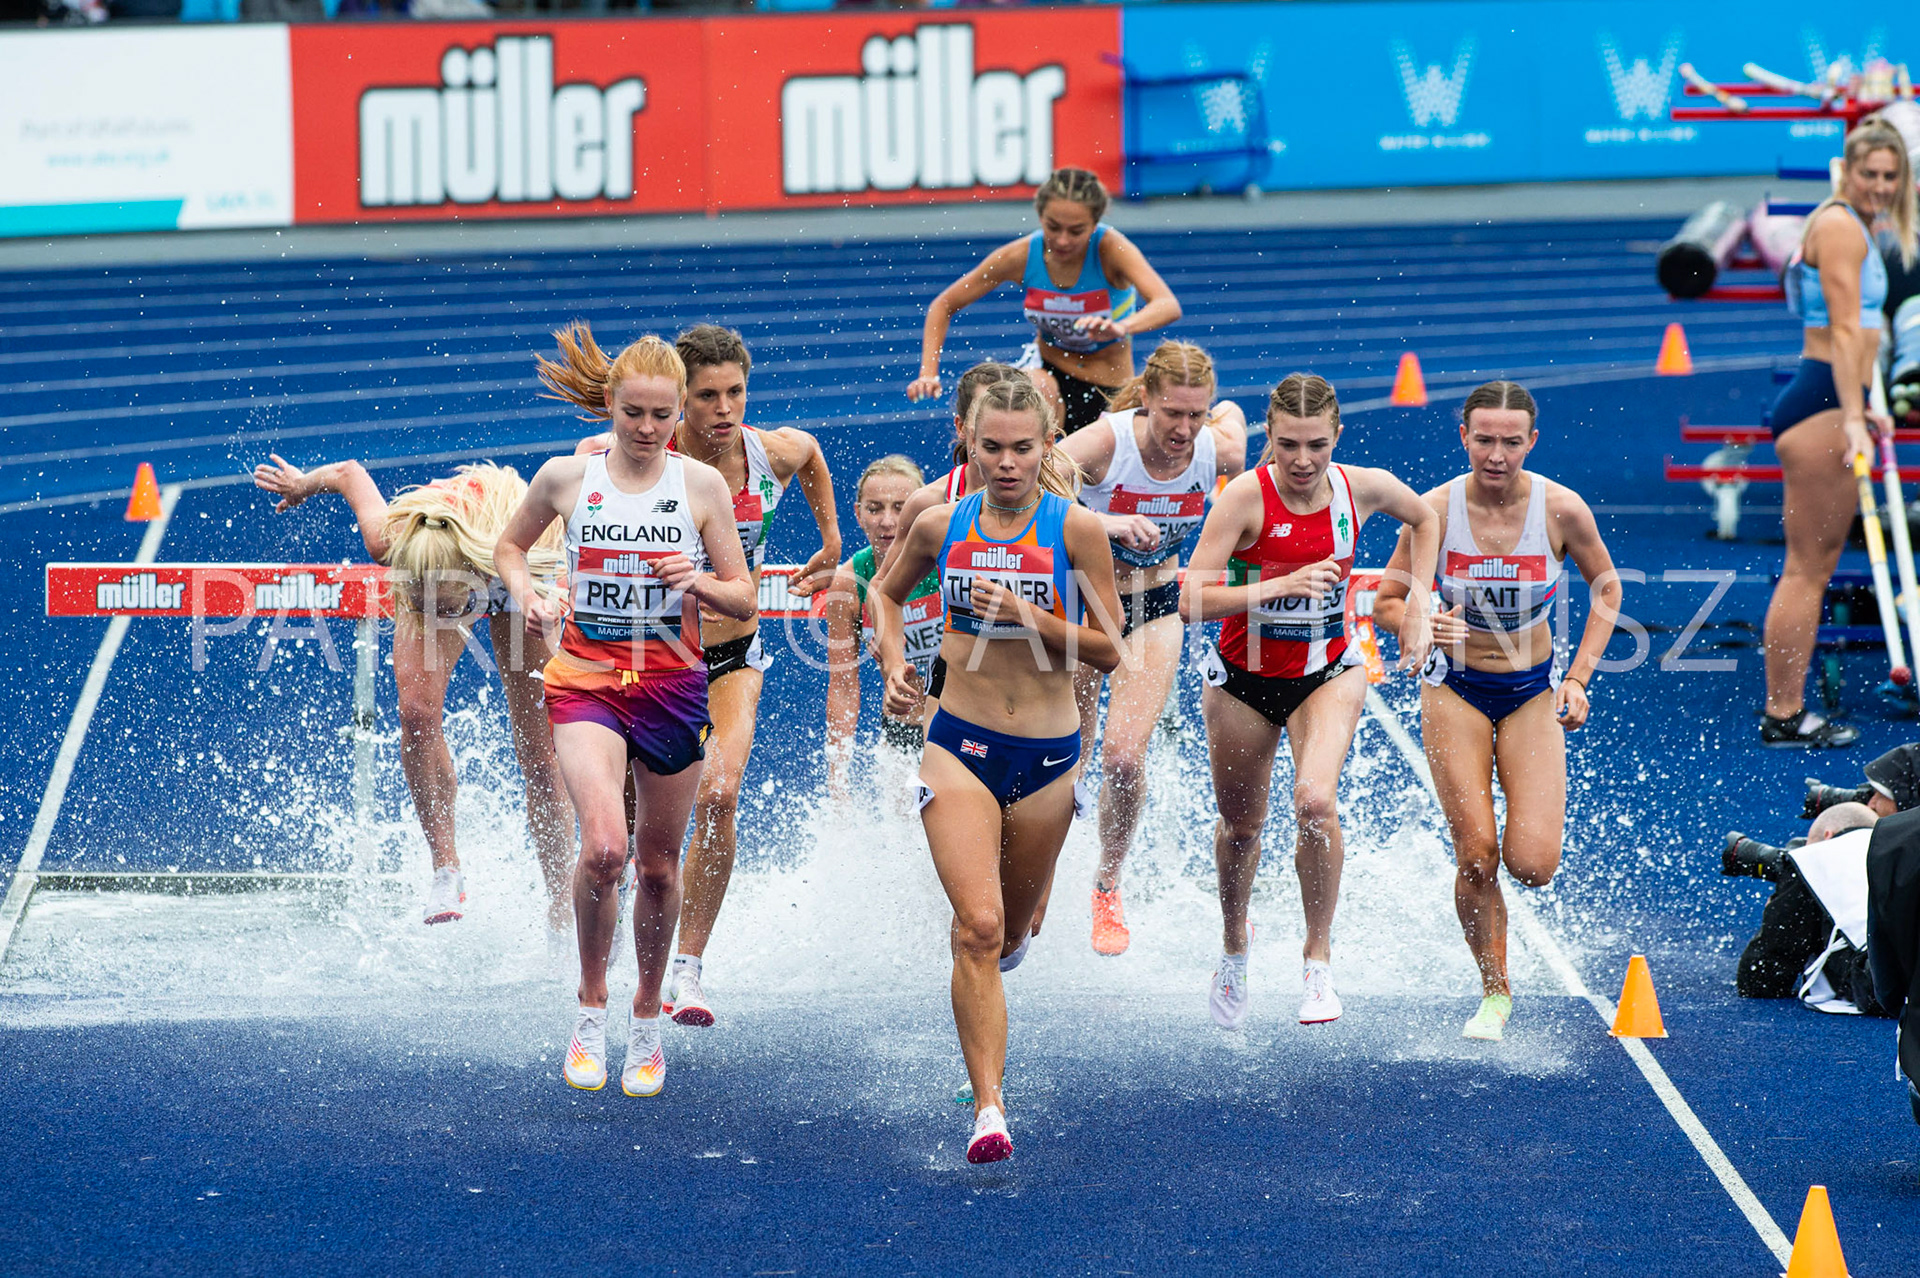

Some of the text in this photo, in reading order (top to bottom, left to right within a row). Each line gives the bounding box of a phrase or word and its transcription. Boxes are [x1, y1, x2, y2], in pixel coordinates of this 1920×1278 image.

[359, 34, 647, 207] müller
[781, 22, 1066, 195] müller
[1136, 496, 1183, 515] müller
[582, 524, 682, 543] ENGLAND
[971, 546, 1024, 570] müller
[1468, 558, 1520, 579] müller
[97, 573, 186, 610] müller
[255, 573, 345, 610] müller
[587, 580, 671, 611] PRATT
[947, 575, 1050, 605] THNER
[1465, 586, 1520, 608] TAIT
[597, 626, 657, 636] MANCHESTER
